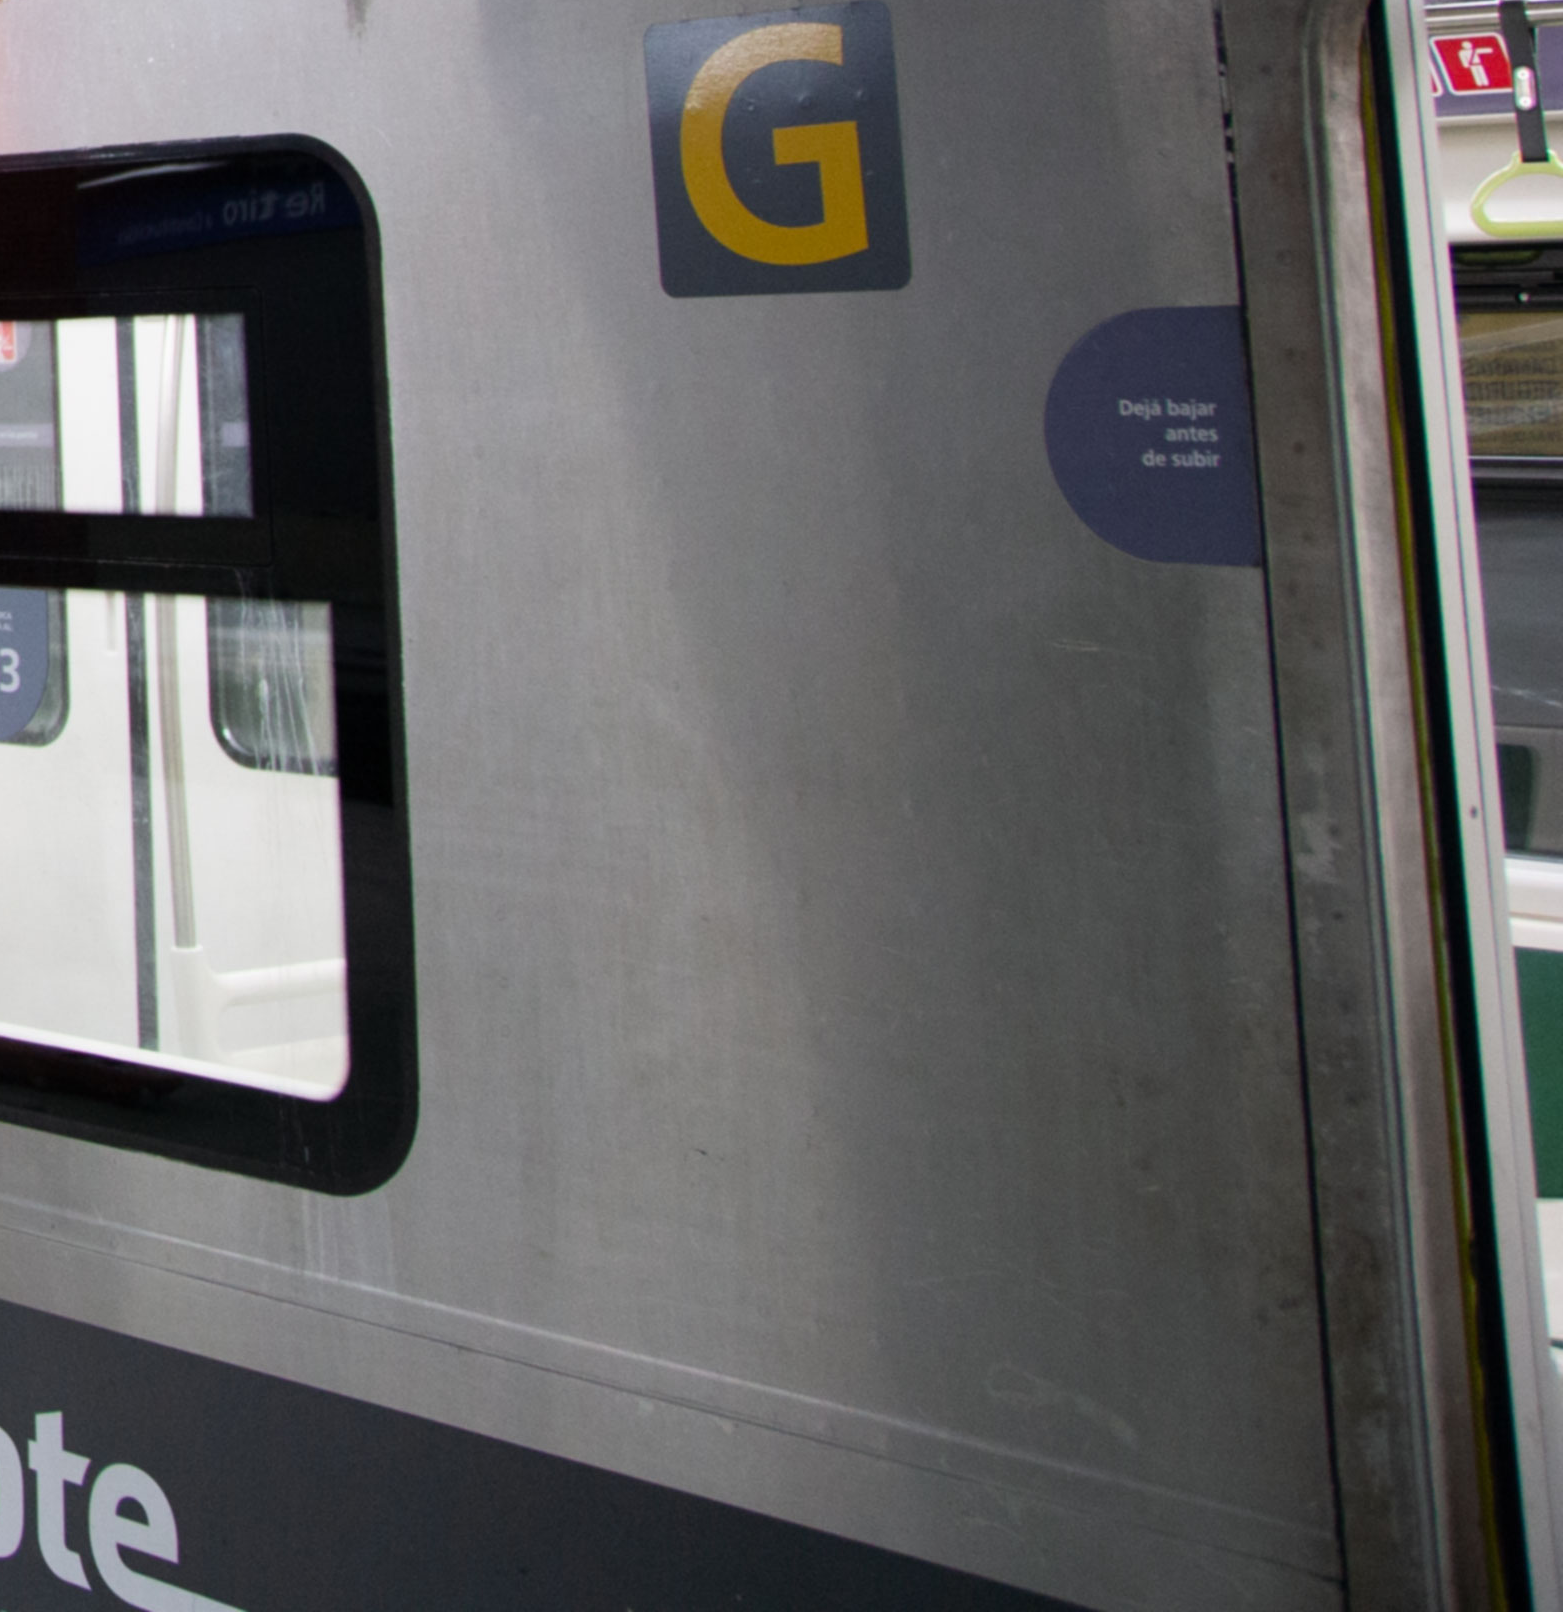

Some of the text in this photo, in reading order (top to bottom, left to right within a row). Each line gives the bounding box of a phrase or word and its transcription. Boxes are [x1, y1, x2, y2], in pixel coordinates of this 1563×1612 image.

[680, 20, 870, 266] G
[1118, 397, 1217, 421] Dejá bajar
[1164, 426, 1218, 442] antes
[1141, 449, 1221, 467] de subir
